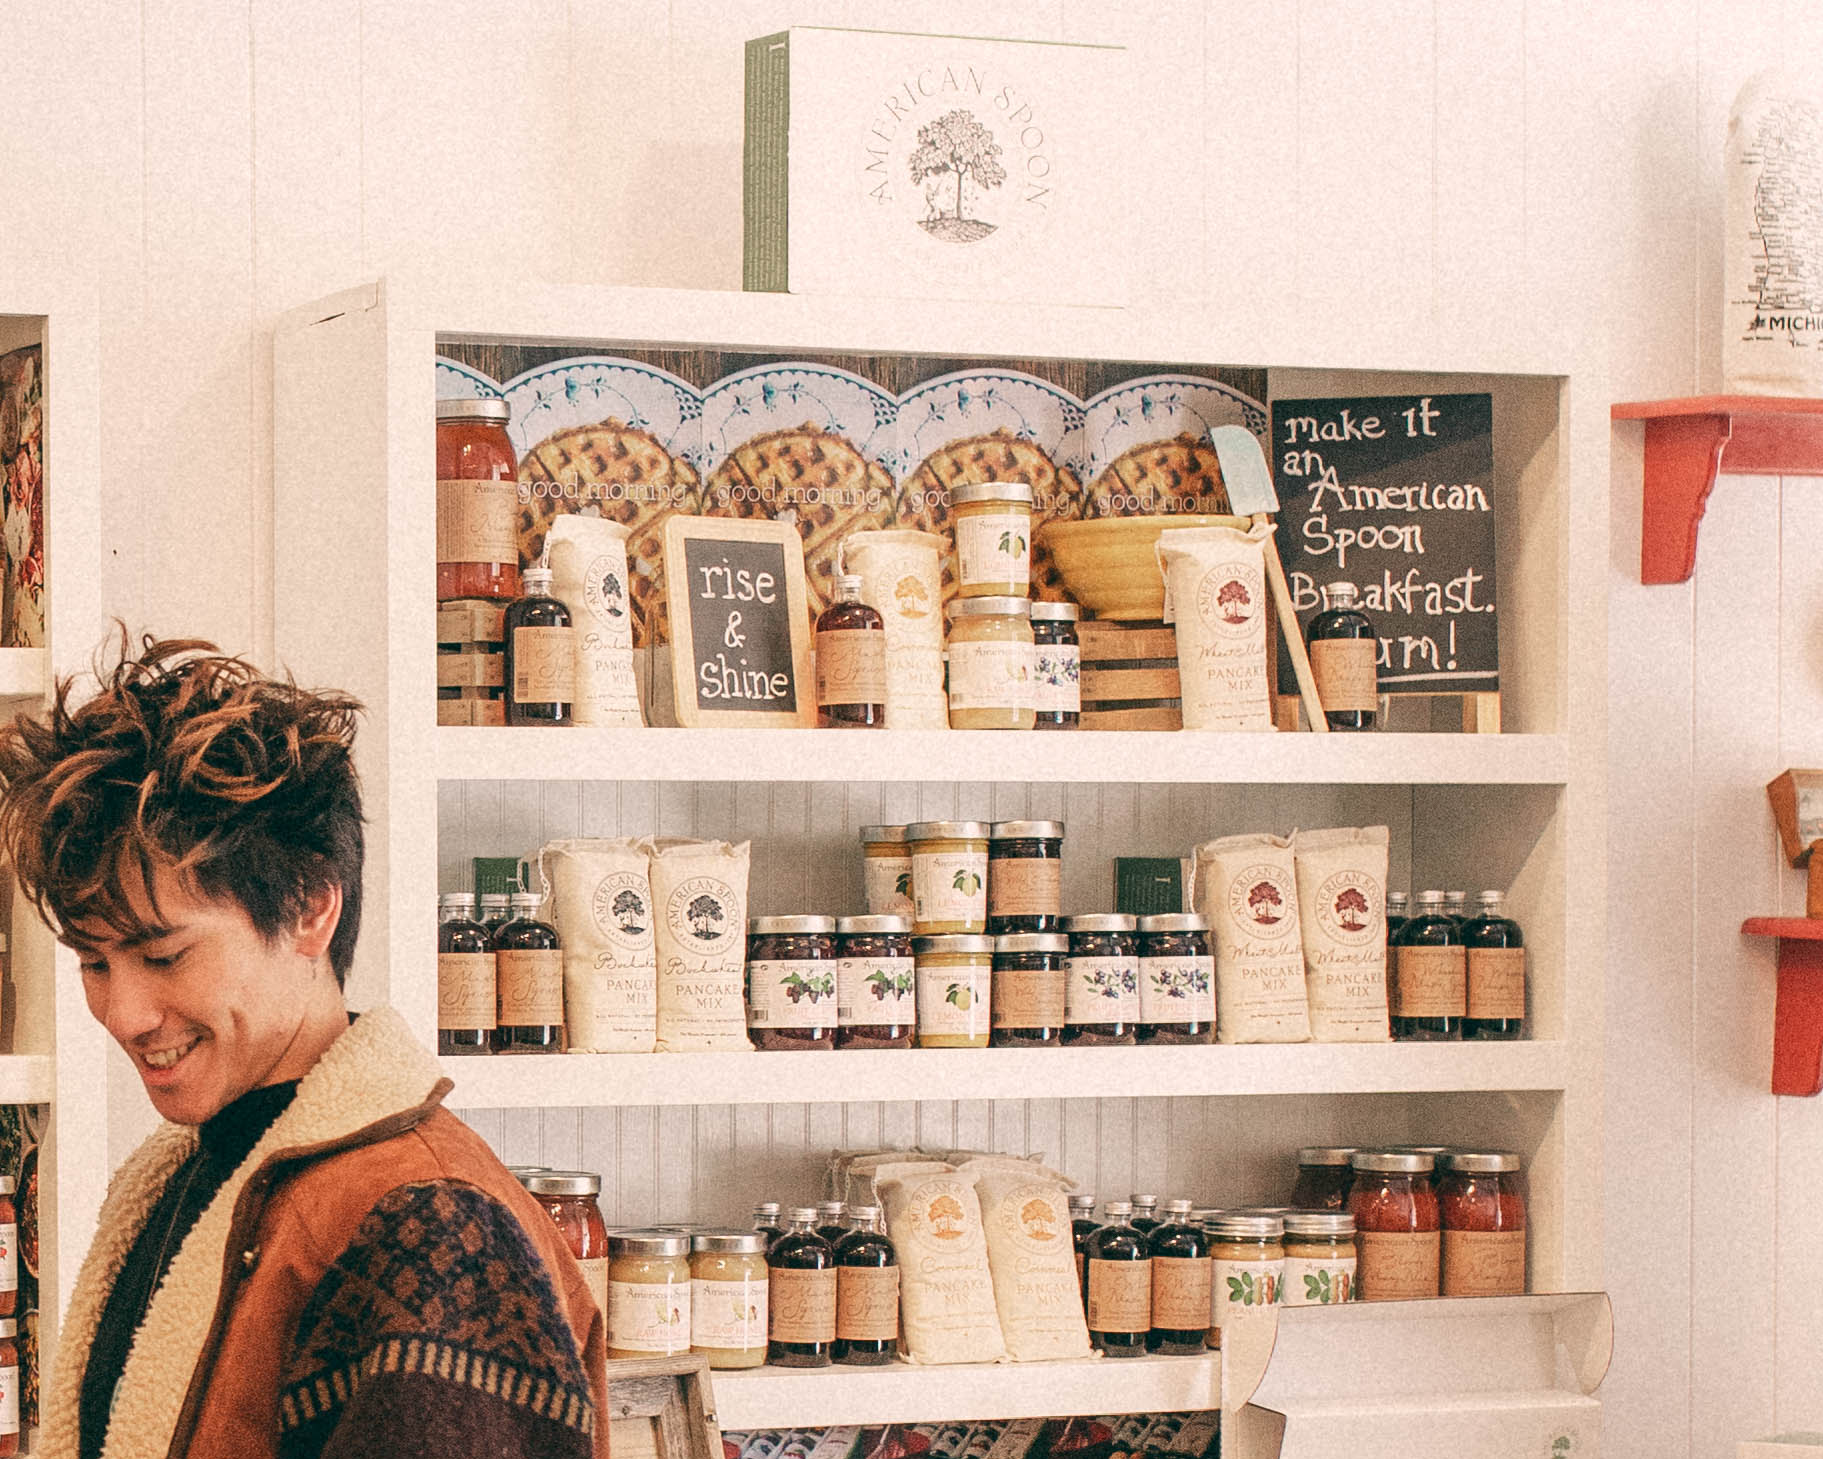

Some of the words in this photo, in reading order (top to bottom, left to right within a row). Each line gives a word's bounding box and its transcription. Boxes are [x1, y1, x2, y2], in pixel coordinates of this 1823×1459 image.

[865, 64, 988, 205] AMERICAN
[994, 85, 1052, 211] SPOON
[1769, 316, 1823, 330] MICHI
[1284, 408, 1386, 444] make
[1402, 398, 1441, 438] it
[1282, 450, 1326, 477] an
[517, 472, 579, 505] good
[587, 482, 688, 508] morning
[717, 477, 777, 507] good
[783, 485, 882, 513] morning
[911, 489, 953, 514] goo
[1098, 486, 1154, 516] good
[1307, 465, 1492, 513] American
[1302, 515, 1425, 569] Spoon
[698, 558, 776, 603] rise
[723, 611, 746, 649] &
[1228, 680, 1253, 690] MIX
[596, 875, 634, 924] AMERICAN
[669, 880, 713, 929] AMERICAN
[1232, 867, 1273, 916] AMERICAN
[1319, 872, 1361, 922] AMERICAN
[1241, 965, 1301, 979] PANCAKE
[1262, 979, 1287, 991] MIX
[1326, 973, 1384, 985] PANCAKE
[626, 992, 648, 1004] MIX
[675, 984, 740, 996] PANCAKE
[697, 998, 722, 1009] MIX
[1345, 986, 1369, 997] MIX
